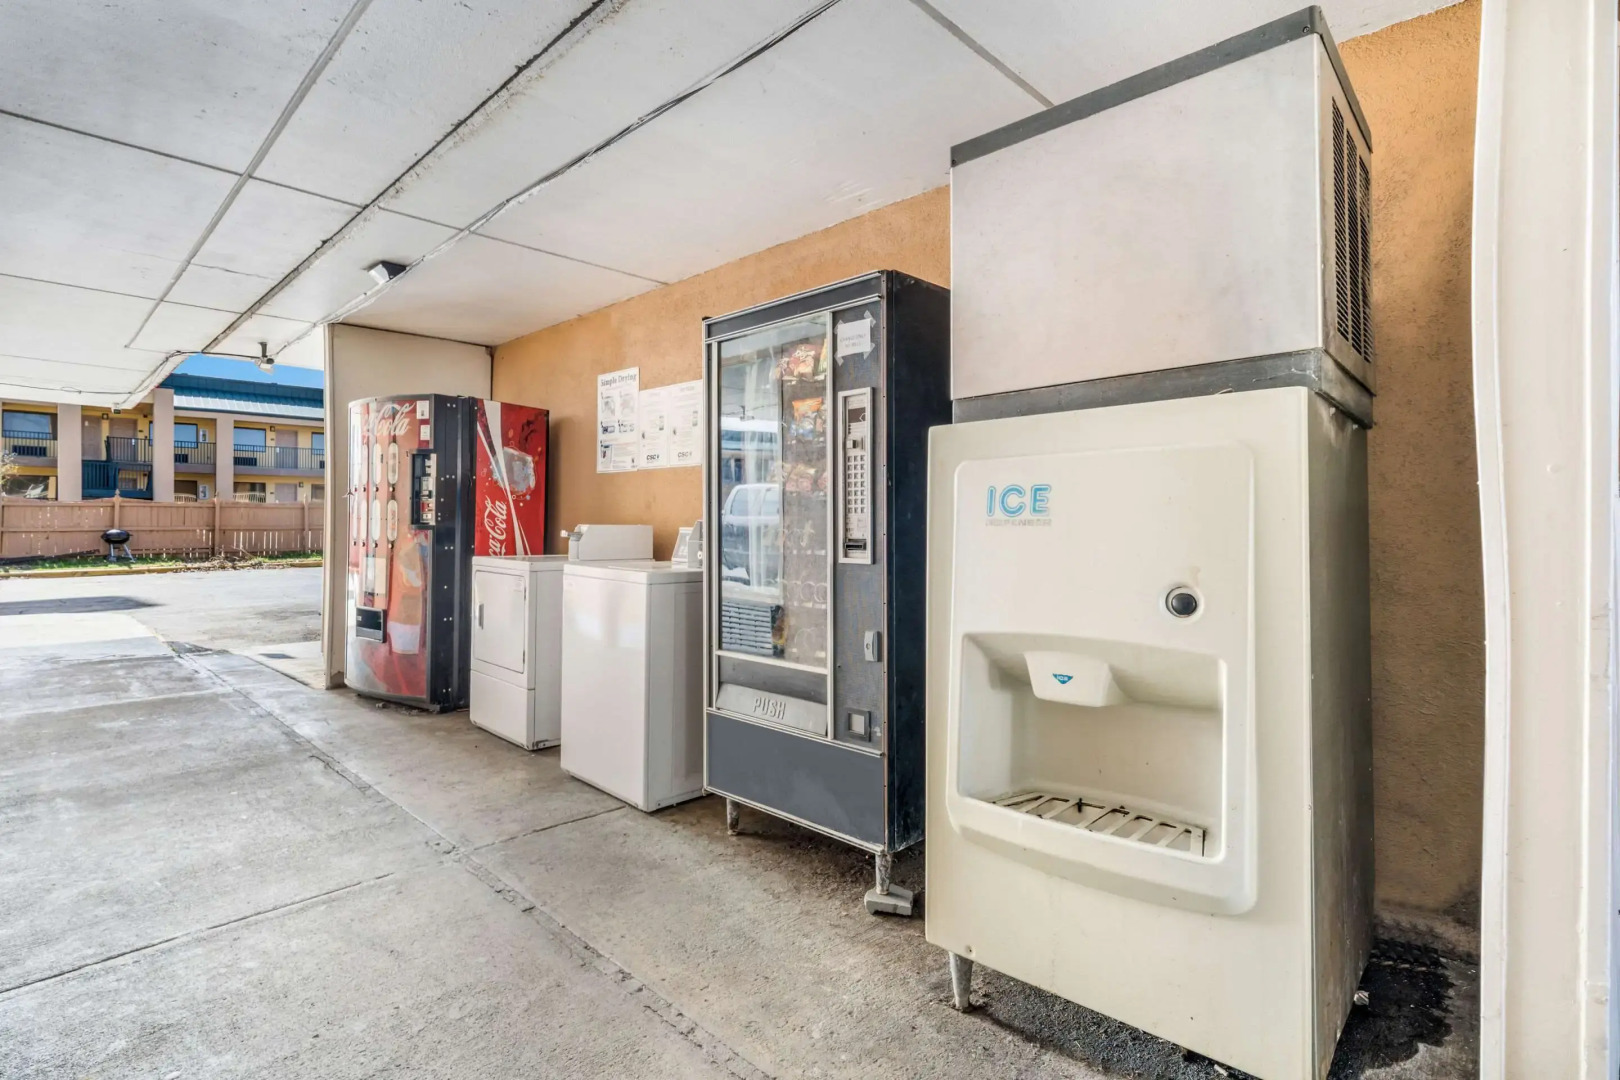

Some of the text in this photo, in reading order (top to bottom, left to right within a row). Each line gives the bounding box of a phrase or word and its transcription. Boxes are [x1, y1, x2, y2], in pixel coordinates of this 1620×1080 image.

[600, 372, 638, 387] Simple Drying
[986, 484, 1052, 518] ICE
[753, 697, 787, 720] PUSH
